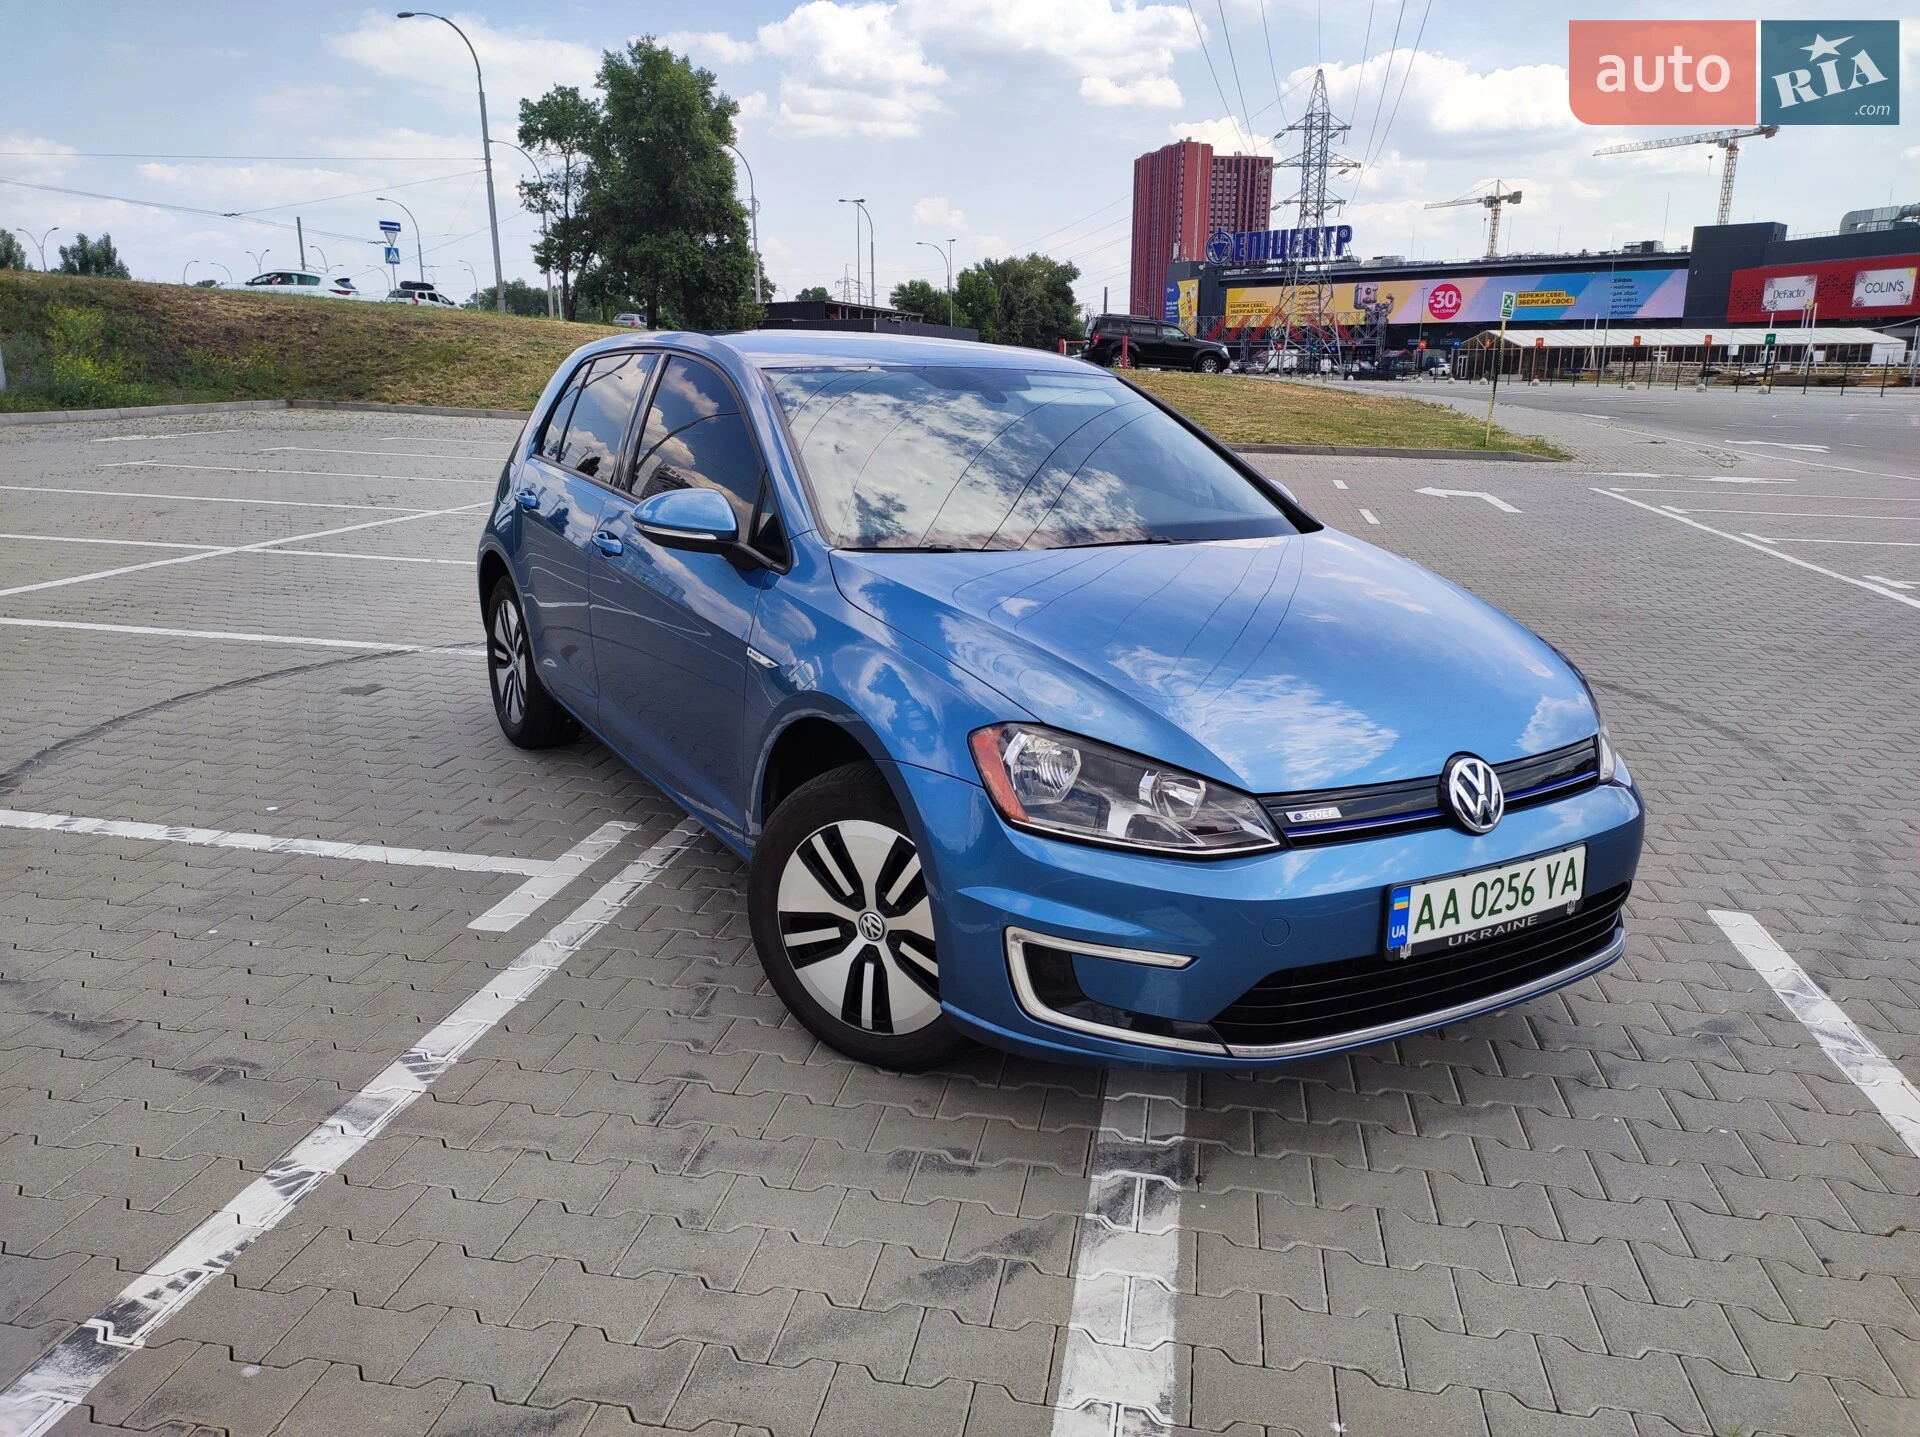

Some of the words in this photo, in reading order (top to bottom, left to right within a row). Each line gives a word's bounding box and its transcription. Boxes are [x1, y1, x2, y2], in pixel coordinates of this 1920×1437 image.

[1864, 280, 1905, 294] COLIN'S
[1413, 888, 1461, 934] AA
[1470, 867, 1537, 920] 0256
[1546, 856, 1578, 900] YA
[1391, 924, 1406, 938] UA
[1447, 914, 1540, 947] UKRAINE
